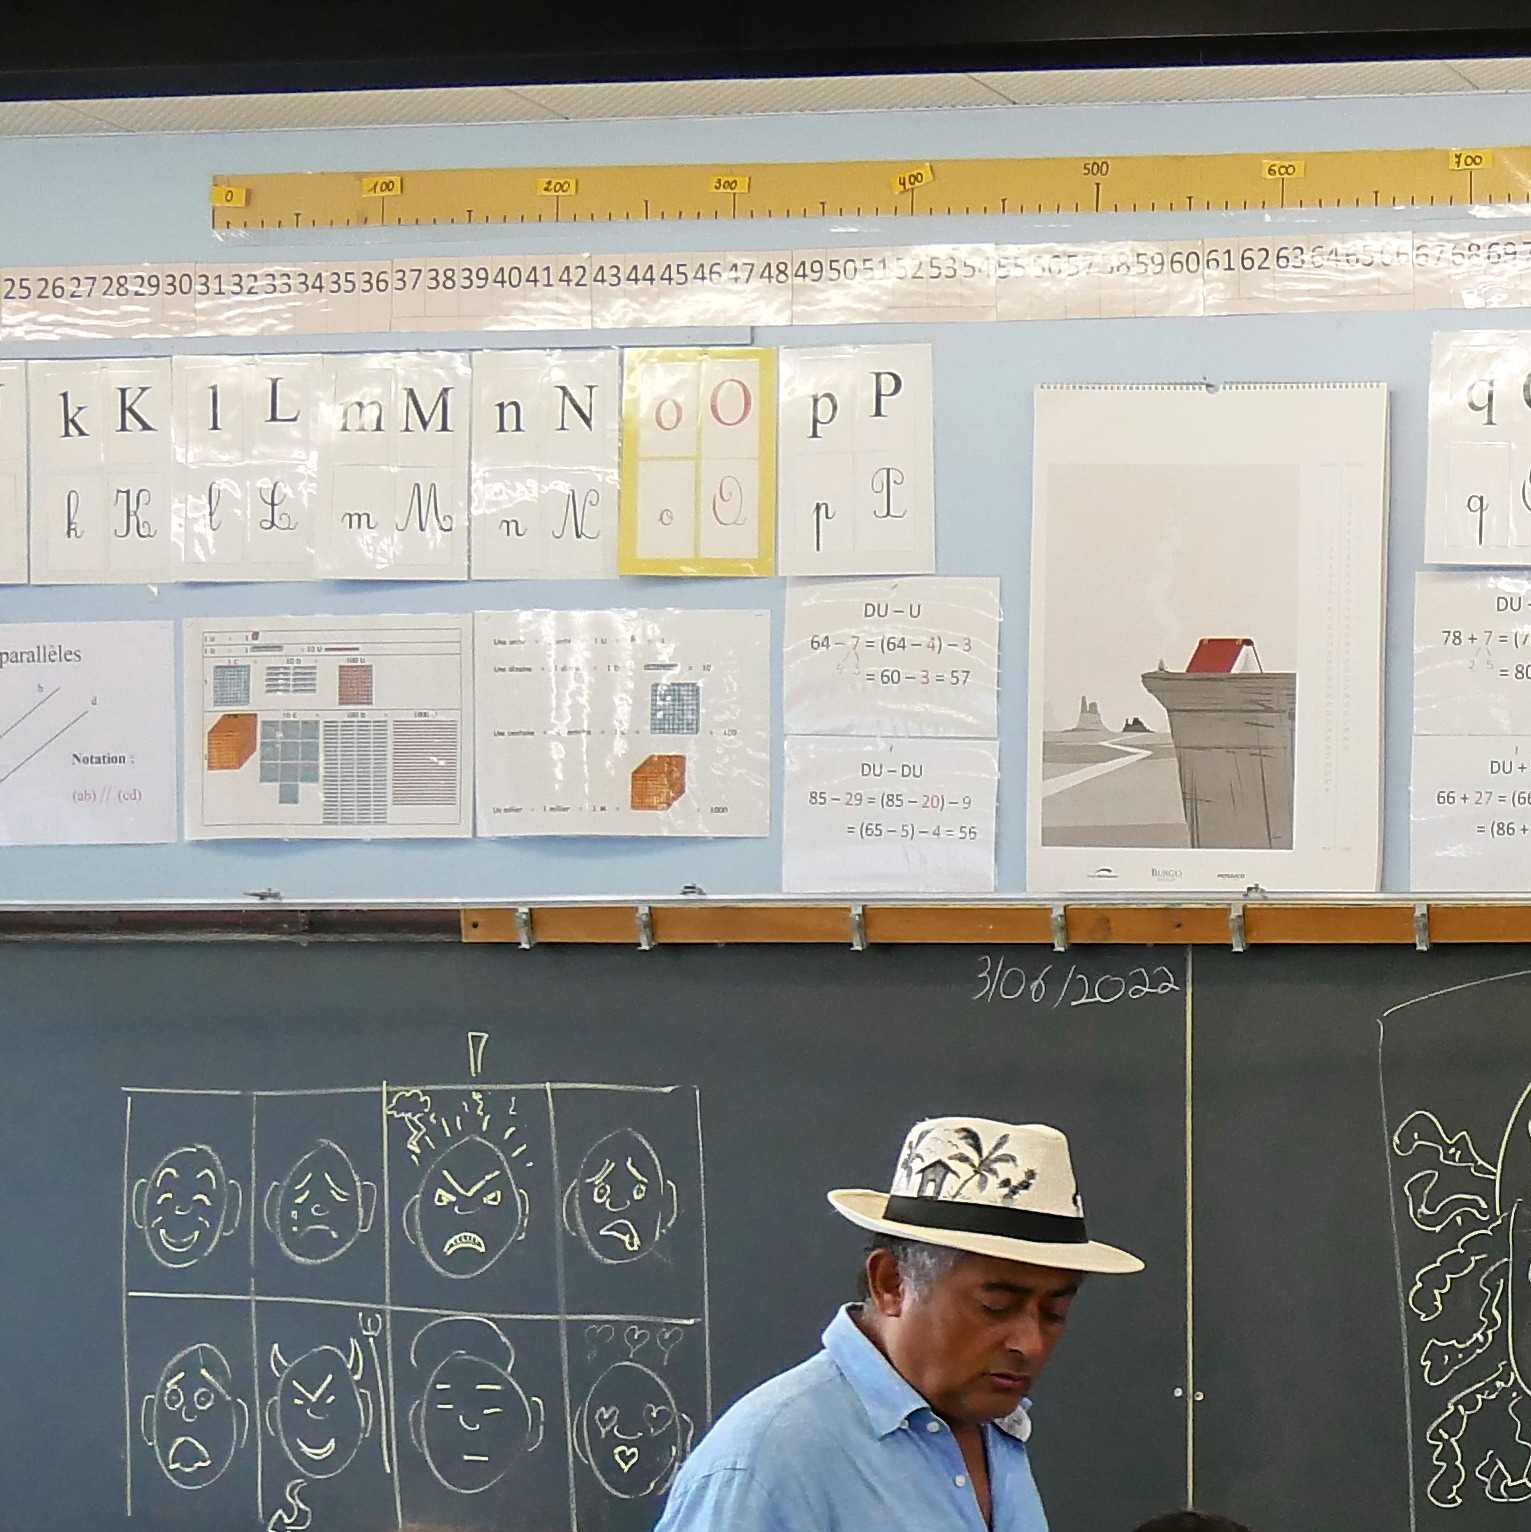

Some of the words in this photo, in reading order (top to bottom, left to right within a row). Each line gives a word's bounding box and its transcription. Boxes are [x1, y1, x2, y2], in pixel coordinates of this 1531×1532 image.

[368, 177, 395, 193] 100
[543, 179, 571, 193] 200
[714, 177, 738, 191] 300
[1084, 161, 1109, 176] 500
[1268, 164, 1295, 176] 600
[1452, 153, 1482, 168] 700
[394, 268, 422, 291] 37
[864, 603, 889, 618] DU
[908, 603, 922, 619] U
[1496, 596, 1522, 612] DU
[0, 644, 82, 669] parallèles
[72, 752, 126, 766] Notation
[1490, 760, 1513, 775] DU
[860, 762, 884, 778] DU
[900, 764, 923, 779] DU
[973, 955, 1180, 1009] 3/06/2022
